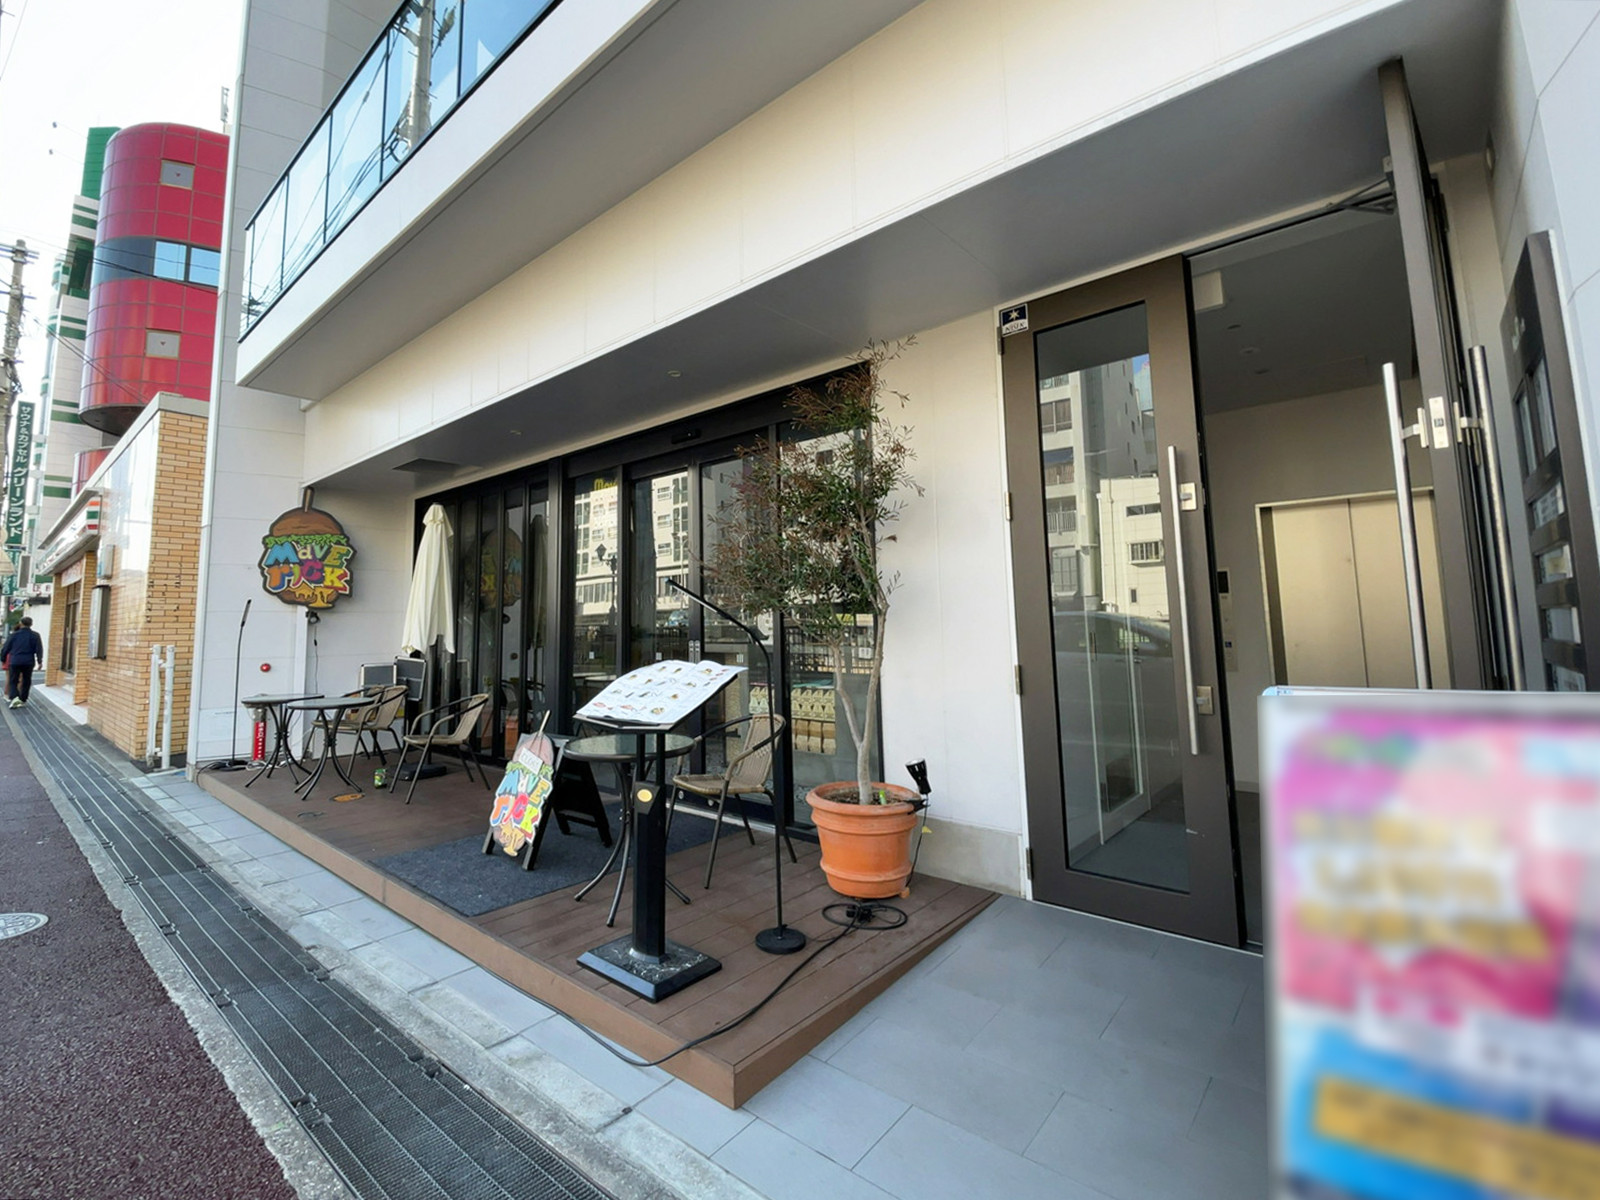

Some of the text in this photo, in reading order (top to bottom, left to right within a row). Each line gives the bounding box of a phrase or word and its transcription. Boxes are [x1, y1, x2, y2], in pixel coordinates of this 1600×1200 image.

[9, 467, 28, 537] グリーンランド
